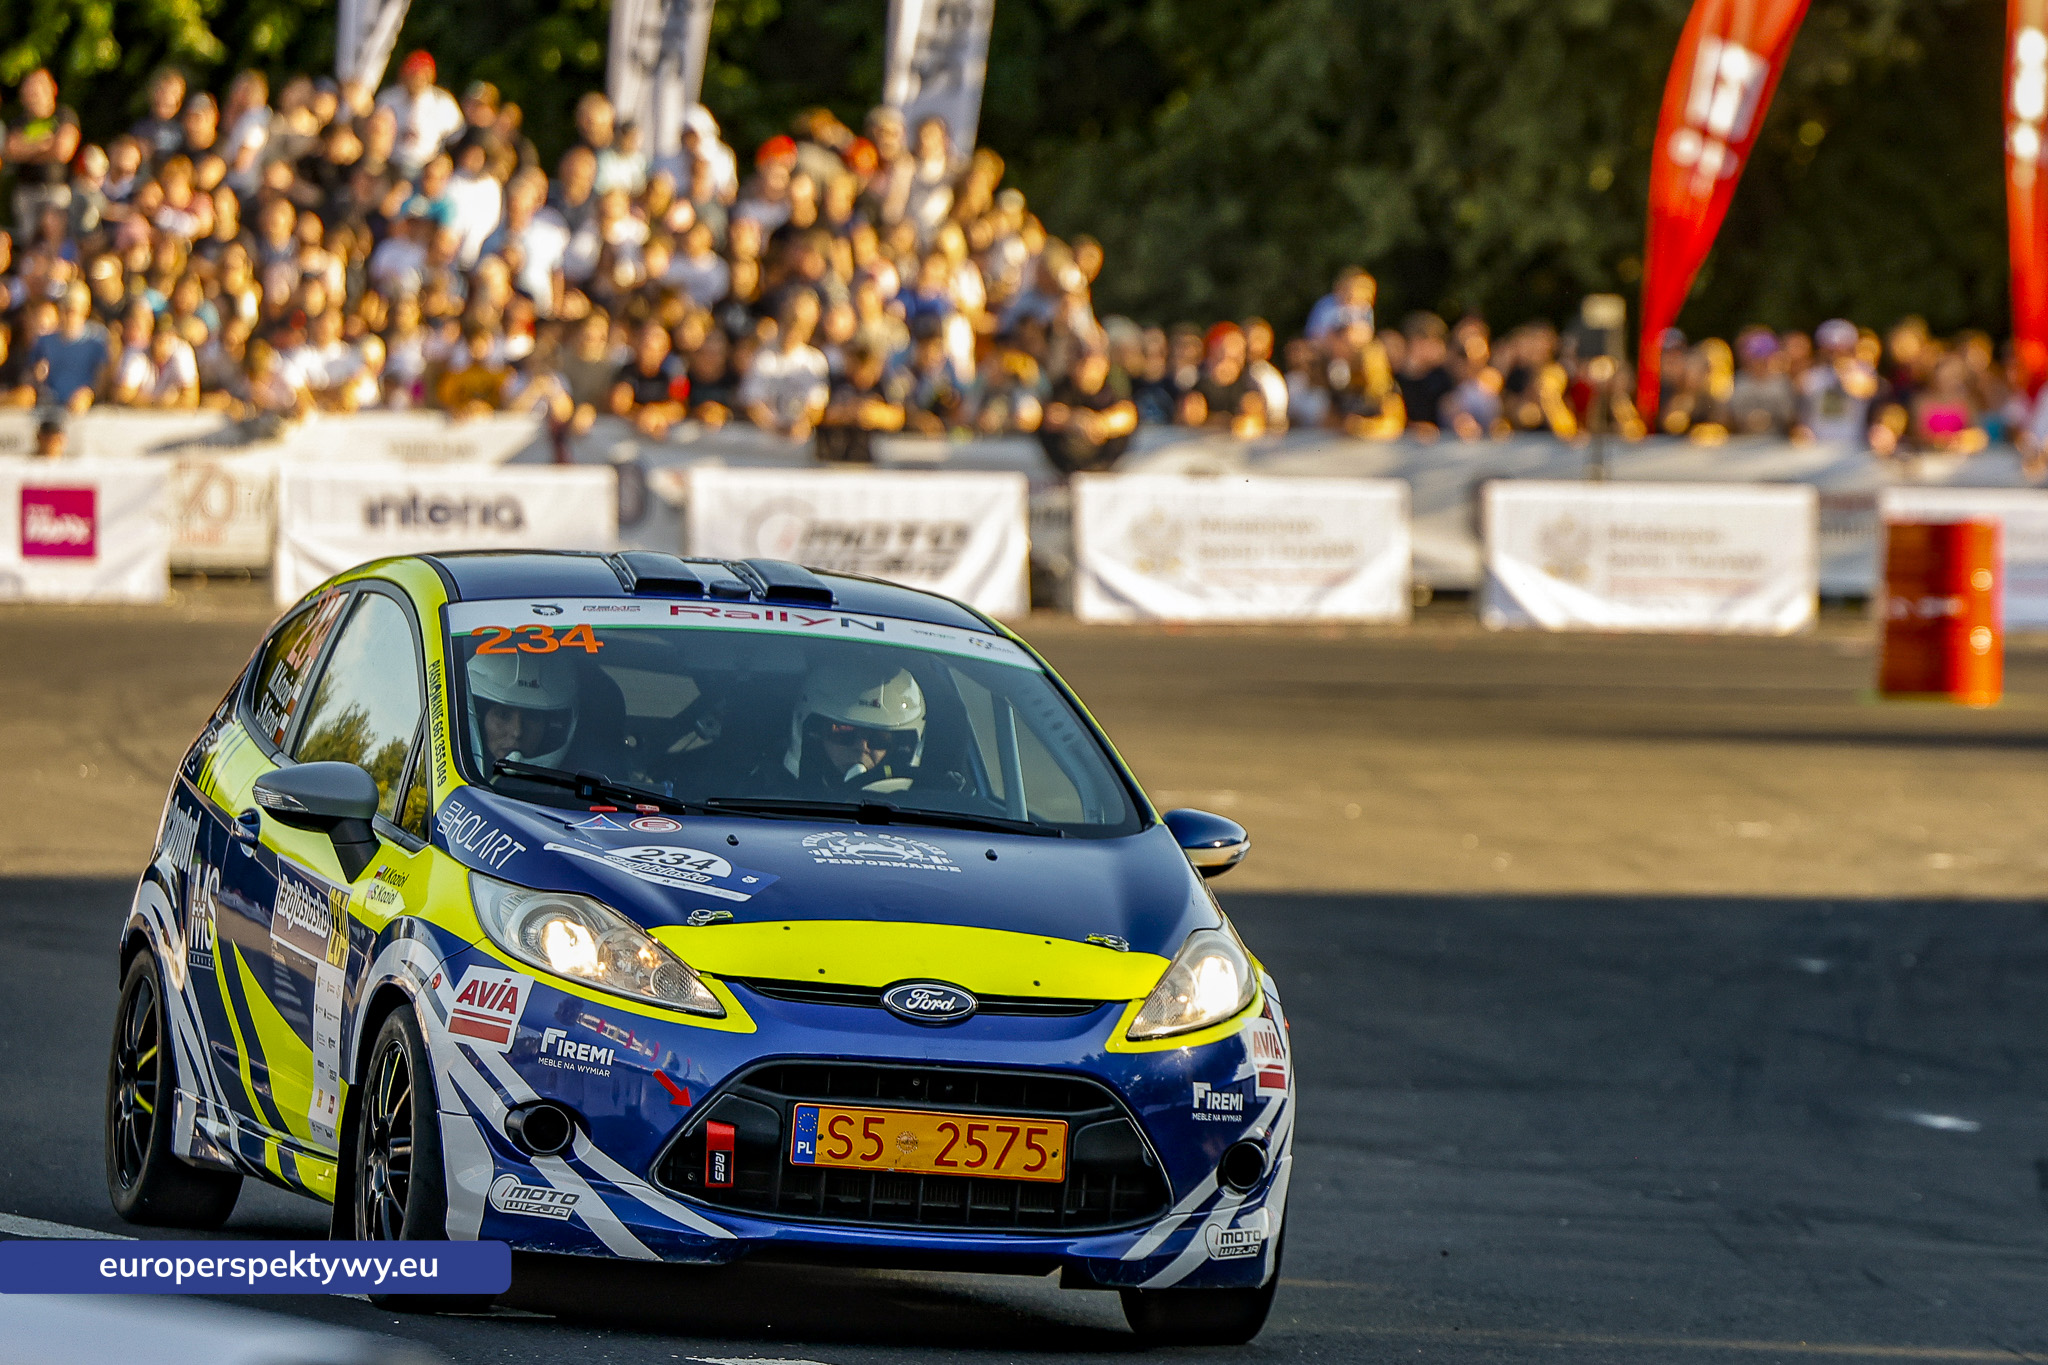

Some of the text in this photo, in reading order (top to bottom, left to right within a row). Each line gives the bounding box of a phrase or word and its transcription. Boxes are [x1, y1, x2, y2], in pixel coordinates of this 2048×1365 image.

[470, 623, 605, 655] 234
[435, 738, 447, 763] 355
[436, 760, 447, 788] 049
[445, 806, 527, 870] HOLART
[630, 848, 718, 871] 234
[813, 857, 962, 873] PERFORMANCE
[905, 988, 956, 1012] Ford
[540, 1027, 615, 1066] FIREMI
[538, 1056, 611, 1078] MEBLE NA WYMIAR
[1192, 1082, 1243, 1111] FIREMI
[1192, 1112, 1211, 1121] MEBLE
[797, 1115, 1049, 1172] PL S5 2575
[507, 1185, 580, 1206] MOTO
[504, 1201, 570, 1218] WIZJA
[1220, 1229, 1262, 1245] MOTO
[1217, 1245, 1260, 1257] WIZJA
